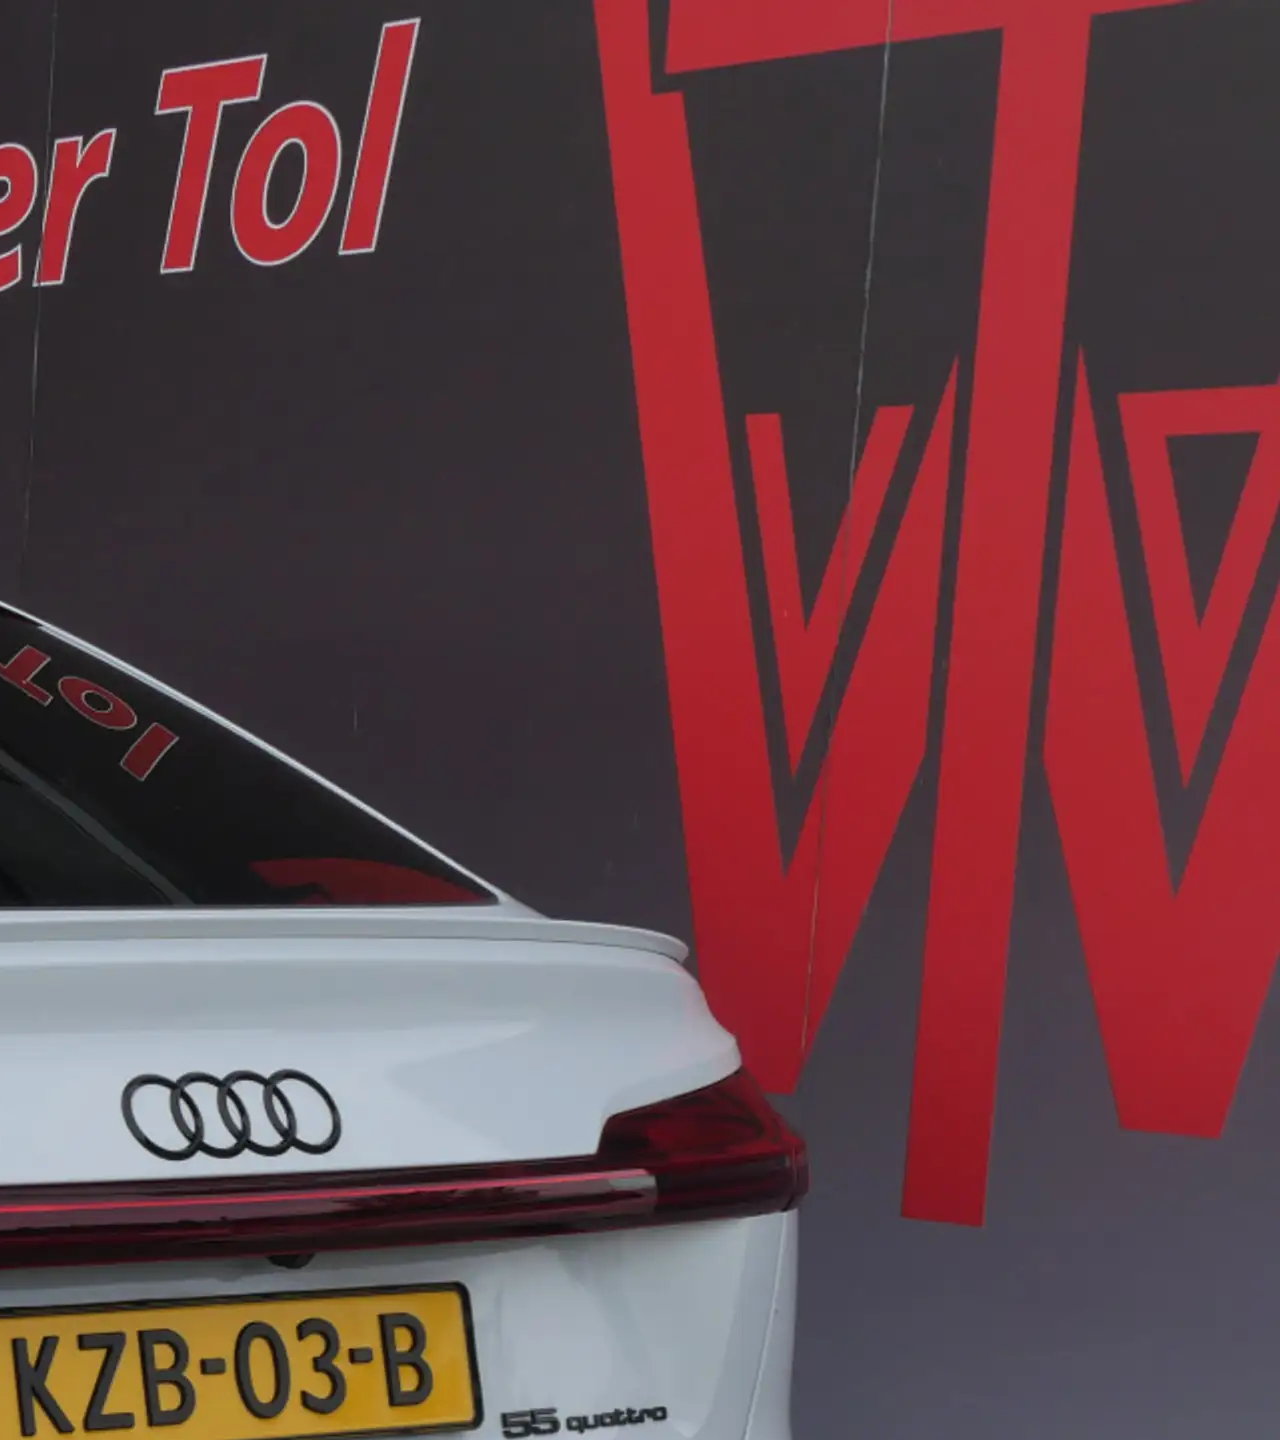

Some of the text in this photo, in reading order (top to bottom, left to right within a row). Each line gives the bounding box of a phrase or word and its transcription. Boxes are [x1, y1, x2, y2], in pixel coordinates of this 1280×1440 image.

[155, 17, 422, 276] Tol
[10, 1311, 435, 1438] KZB-03-B
[500, 1406, 668, 1440] 55 quattro
